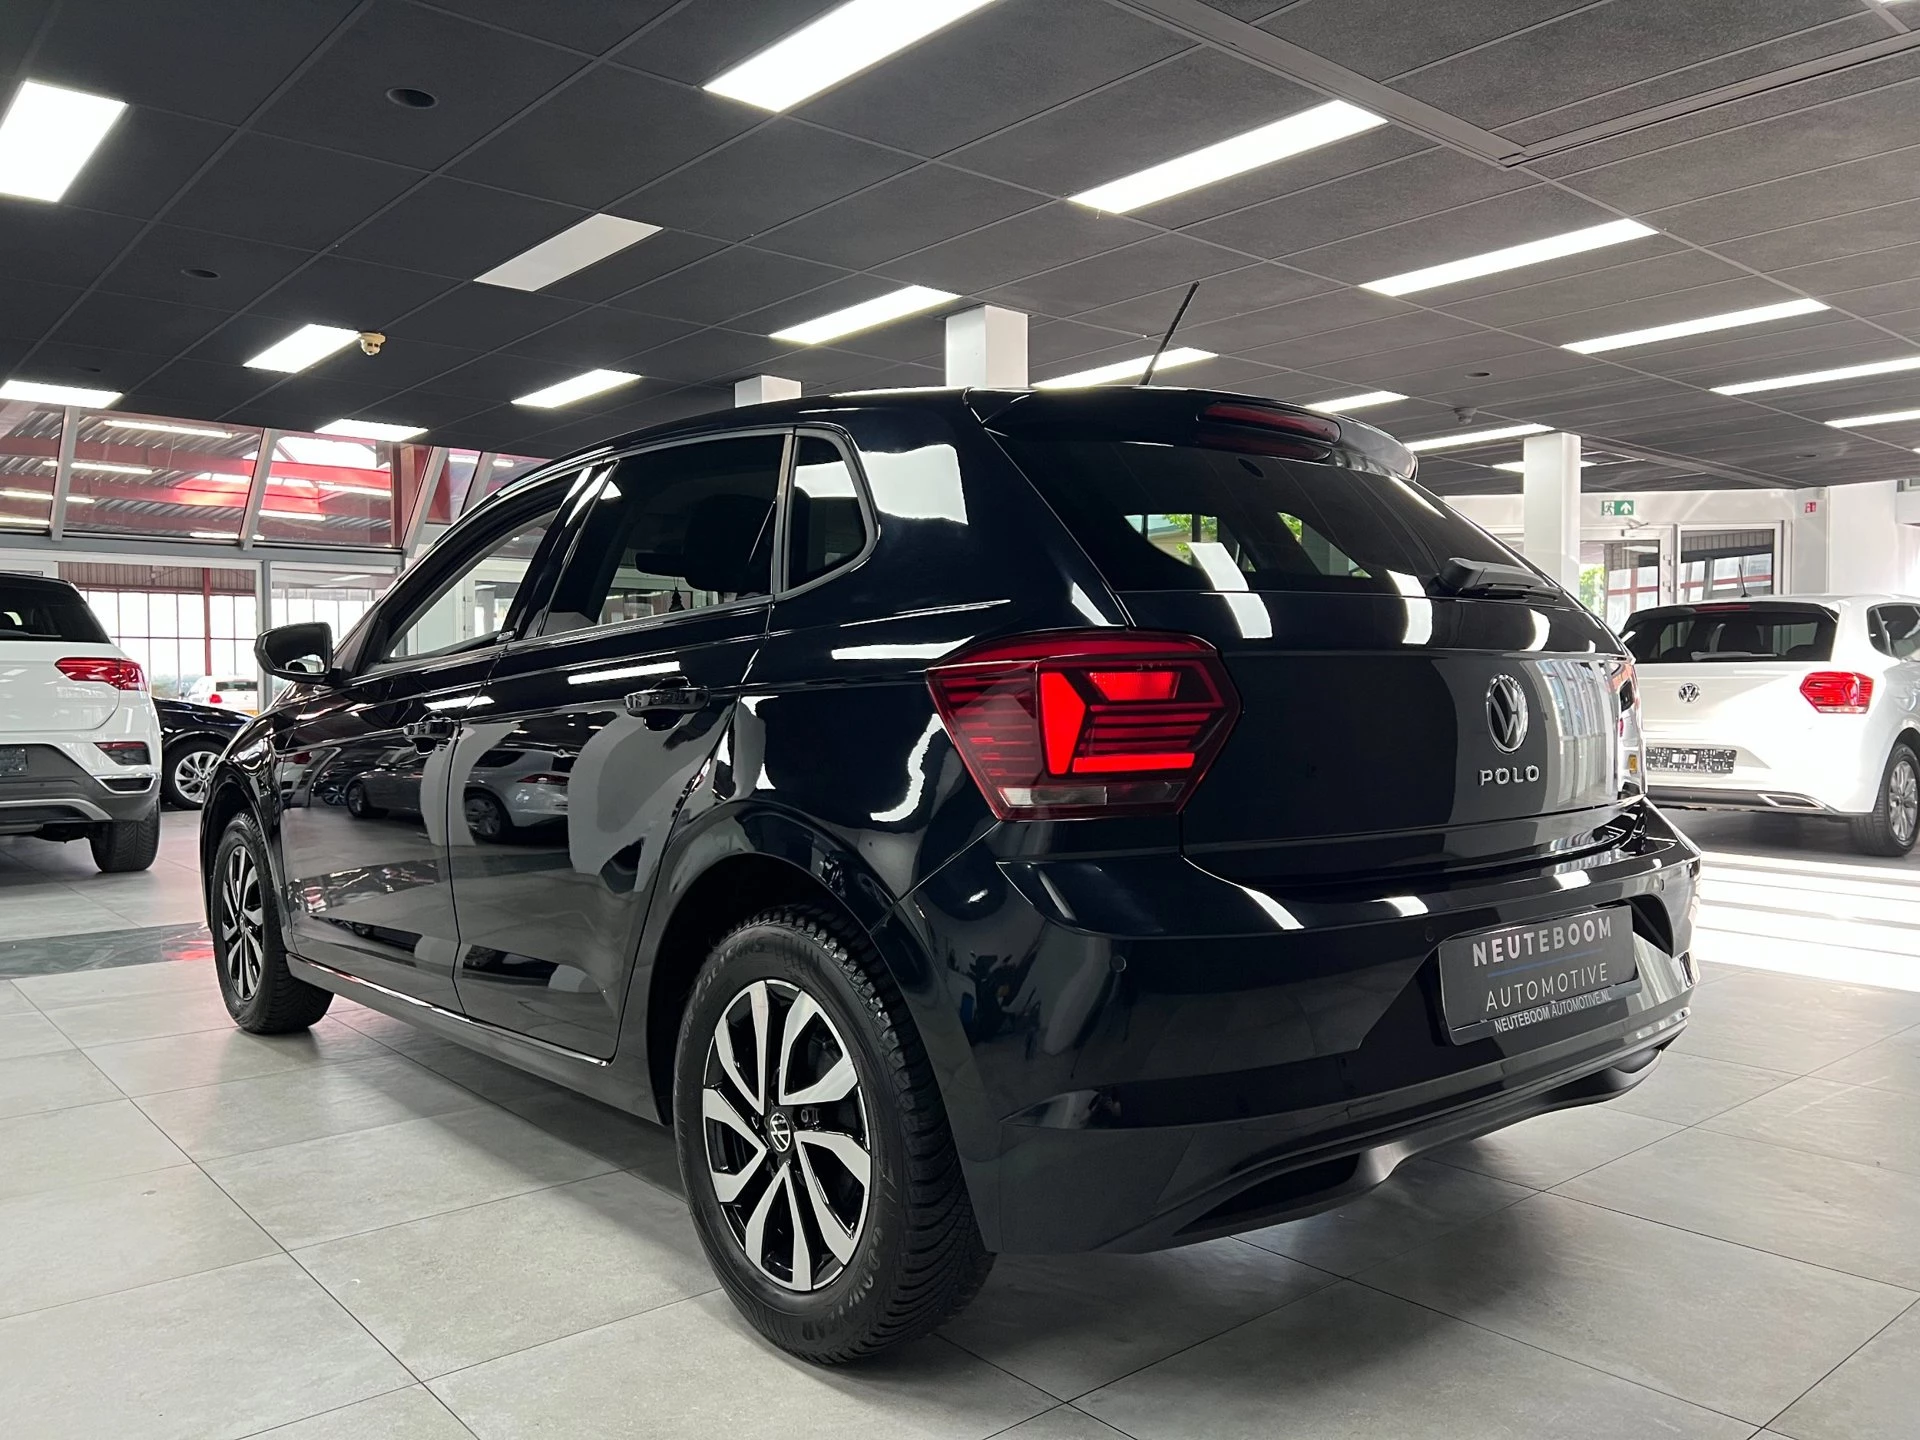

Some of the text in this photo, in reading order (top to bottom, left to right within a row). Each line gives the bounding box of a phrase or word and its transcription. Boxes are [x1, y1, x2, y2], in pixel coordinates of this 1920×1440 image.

[1479, 764, 1540, 786] POLO
[1472, 916, 1612, 967] NEUTEBOOM
[1486, 962, 1608, 1012] AUTOMOTIVE
[1494, 1006, 1551, 1034] NEUTEBOOM
